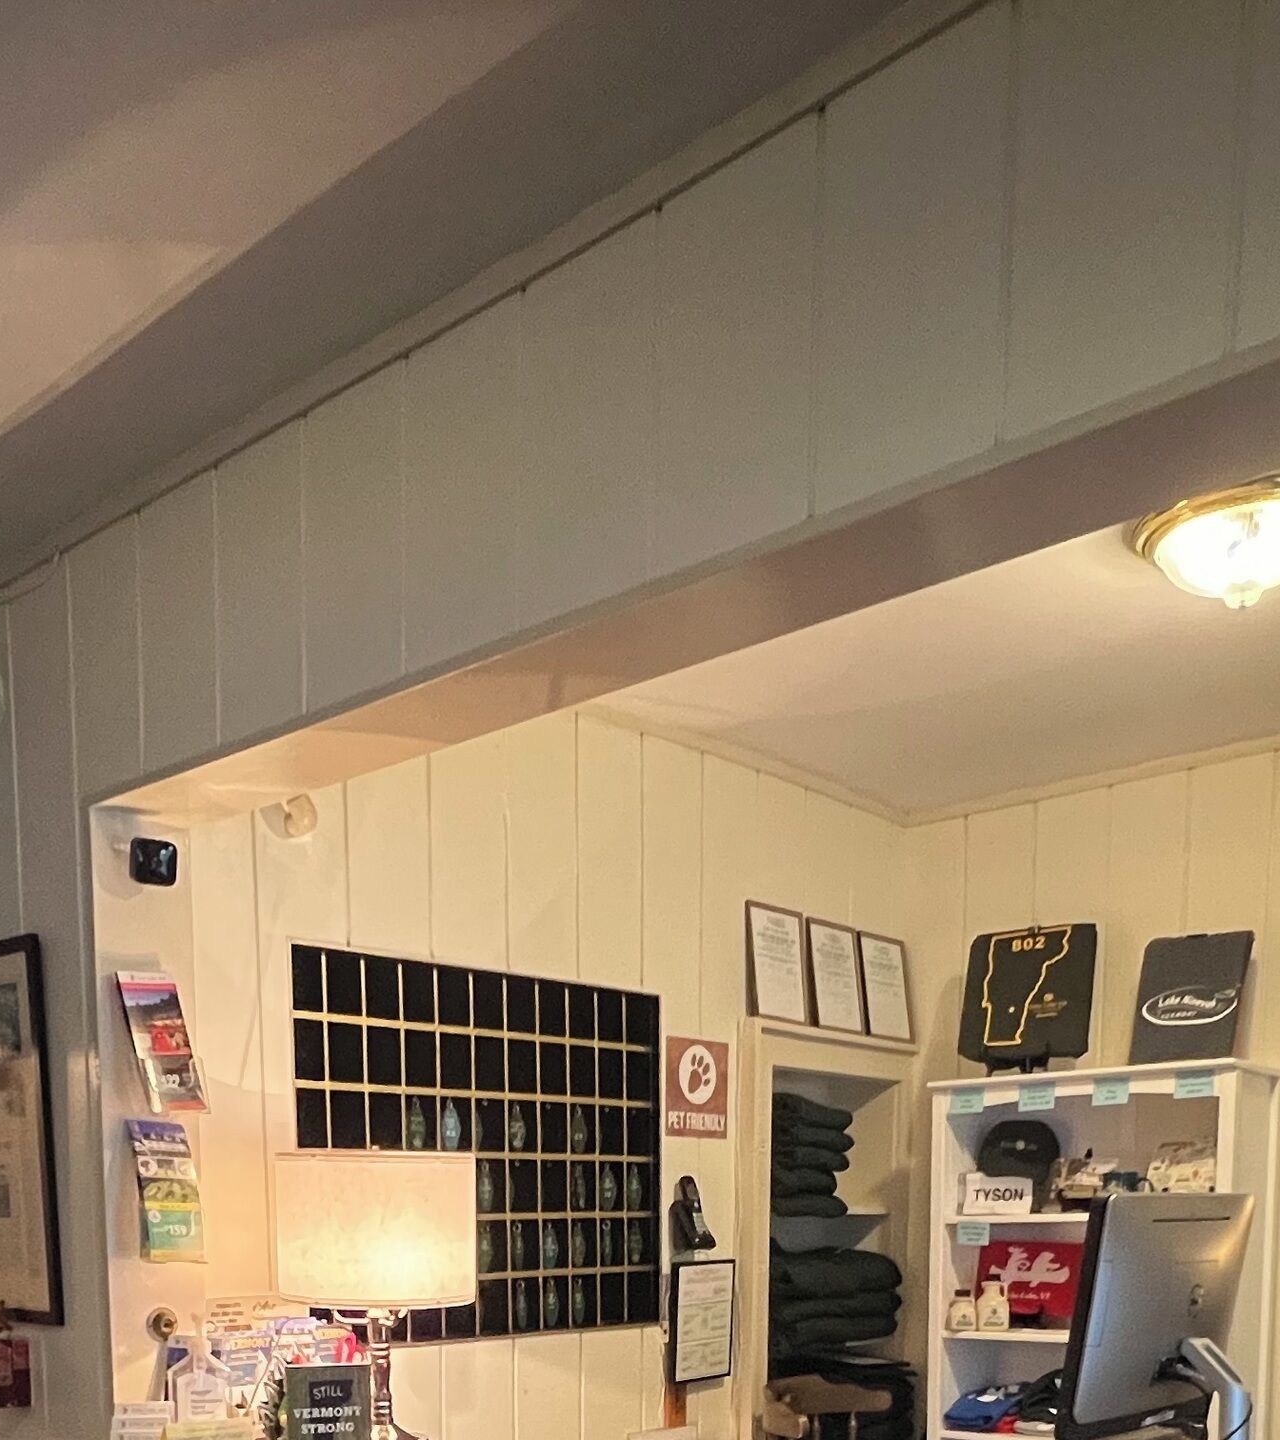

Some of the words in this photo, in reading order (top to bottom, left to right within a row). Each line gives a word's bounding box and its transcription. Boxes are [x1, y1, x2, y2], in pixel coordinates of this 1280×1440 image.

[668, 1111, 685, 1129] PET
[686, 1112, 726, 1132] FRIENDLY
[973, 1187, 1024, 1202] TYSON
[313, 1385, 344, 1400] STILL
[293, 1405, 362, 1419] VERMONT
[301, 1421, 355, 1435] STRONG
